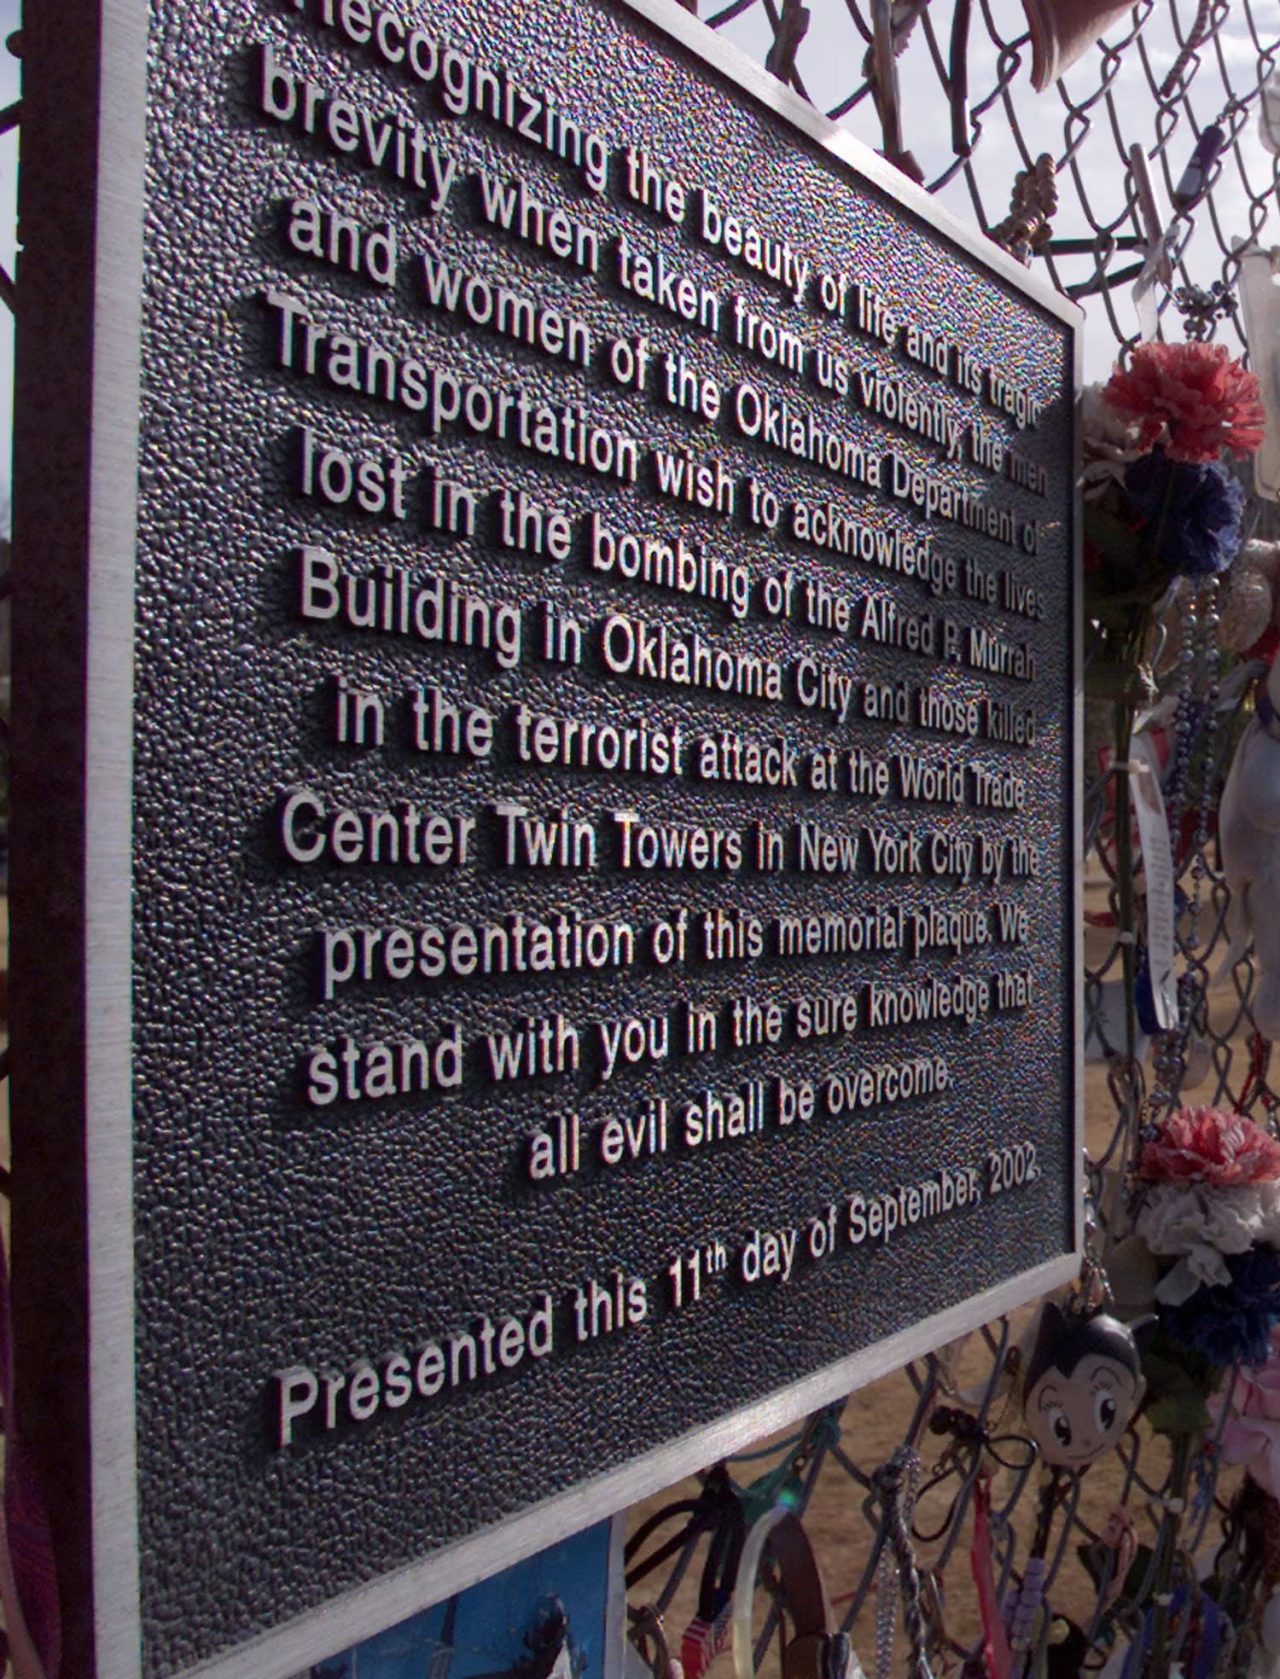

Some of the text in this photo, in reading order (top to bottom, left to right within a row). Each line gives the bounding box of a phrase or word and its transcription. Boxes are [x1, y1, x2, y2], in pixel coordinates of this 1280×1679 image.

[262, 44, 1048, 497] brevity when taken from us violently, the men
[295, 0, 1042, 430] ecognizing the beauty of life and its tragic
[268, 291, 1045, 618] Transportation wish to acknowledge the lives
[289, 201, 1042, 555] and women of the Oklahoma Department of
[301, 428, 1037, 682] lost in the bombing of the Alfred P. Murrah
[301, 546, 1037, 745] Building in Oklahoma City and those killed
[282, 791, 1039, 885] Center Twin Towers in New York City by the
[336, 675, 1025, 810] in the terrorist attack at the World Trade
[308, 971, 1033, 1106] stand with you in the sure knowledge that
[324, 902, 1029, 999] presentation of this memorial plaque. We
[530, 1057, 953, 1180] all evil shall be overcome.
[278, 1295, 553, 1449] Presented
[575, 1269, 647, 1342] this
[669, 1242, 726, 1308] 11th
[742, 1229, 796, 1283] day
[810, 1204, 837, 1259] of
[850, 1167, 981, 1245] September,
